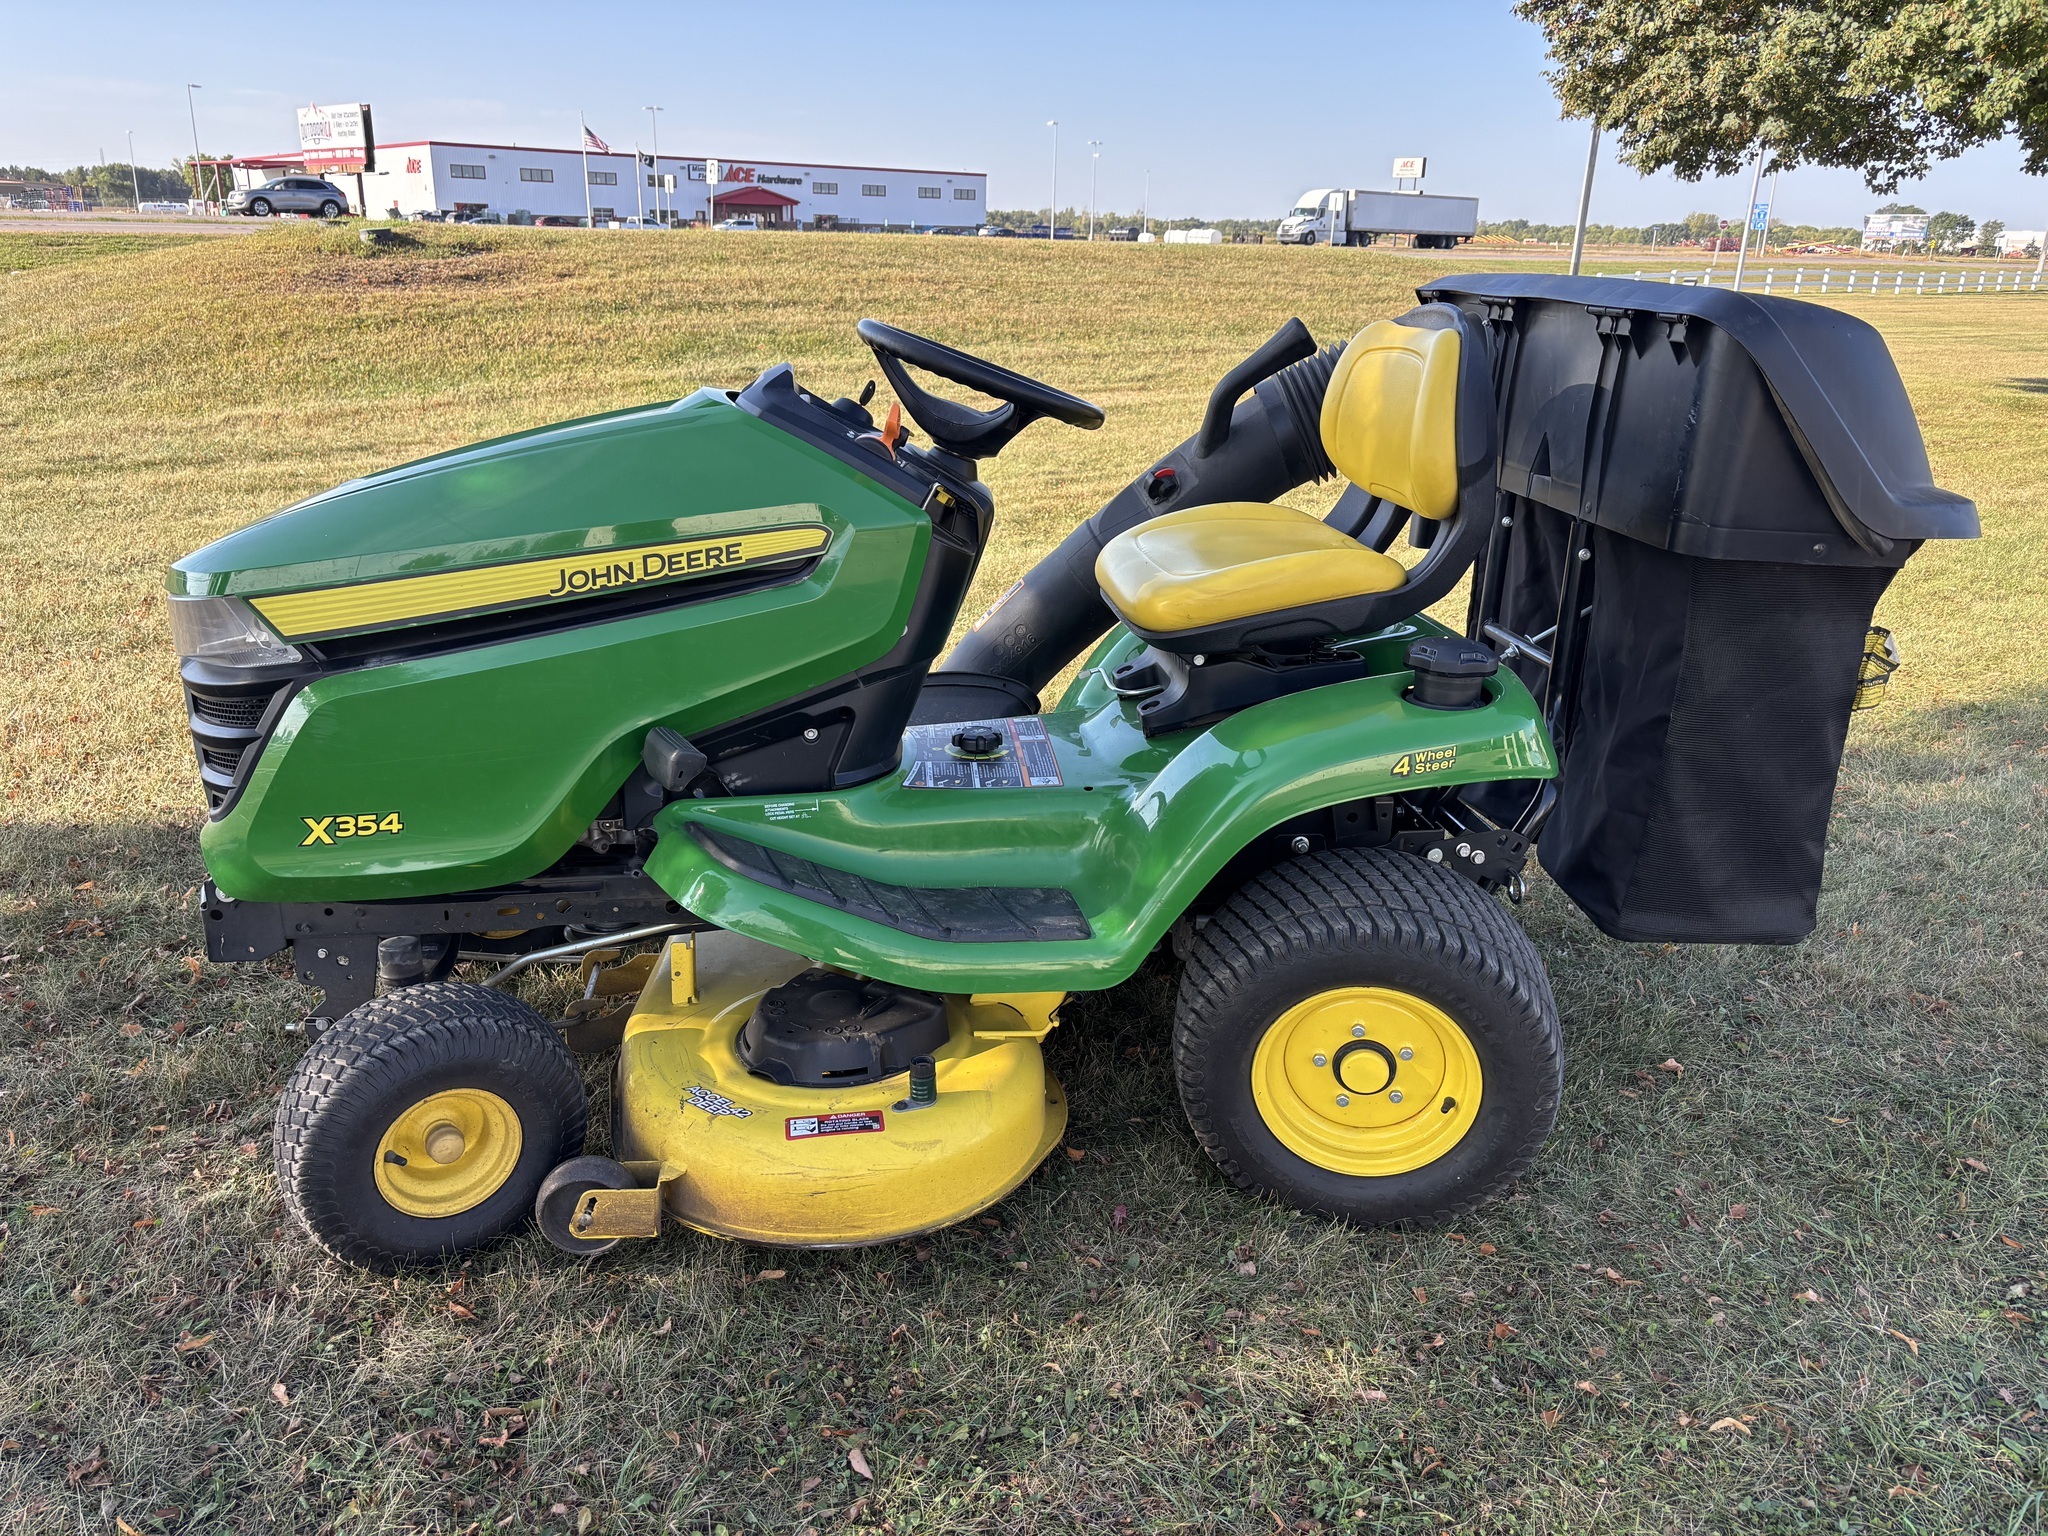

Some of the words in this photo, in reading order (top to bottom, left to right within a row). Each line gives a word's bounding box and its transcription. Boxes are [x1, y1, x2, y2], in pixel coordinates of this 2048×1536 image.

[724, 163, 756, 183] ACE
[757, 173, 803, 185] Hardware
[549, 561, 635, 594] JOHN
[642, 542, 743, 578] DEERE
[1391, 755, 1411, 776] 4
[1415, 746, 1457, 764] Wheel
[1414, 758, 1456, 774] Steer
[299, 811, 403, 847] X354
[682, 1086, 735, 1110] ACCEL
[685, 1096, 732, 1116] DEEP
[731, 1107, 753, 1119] 42
